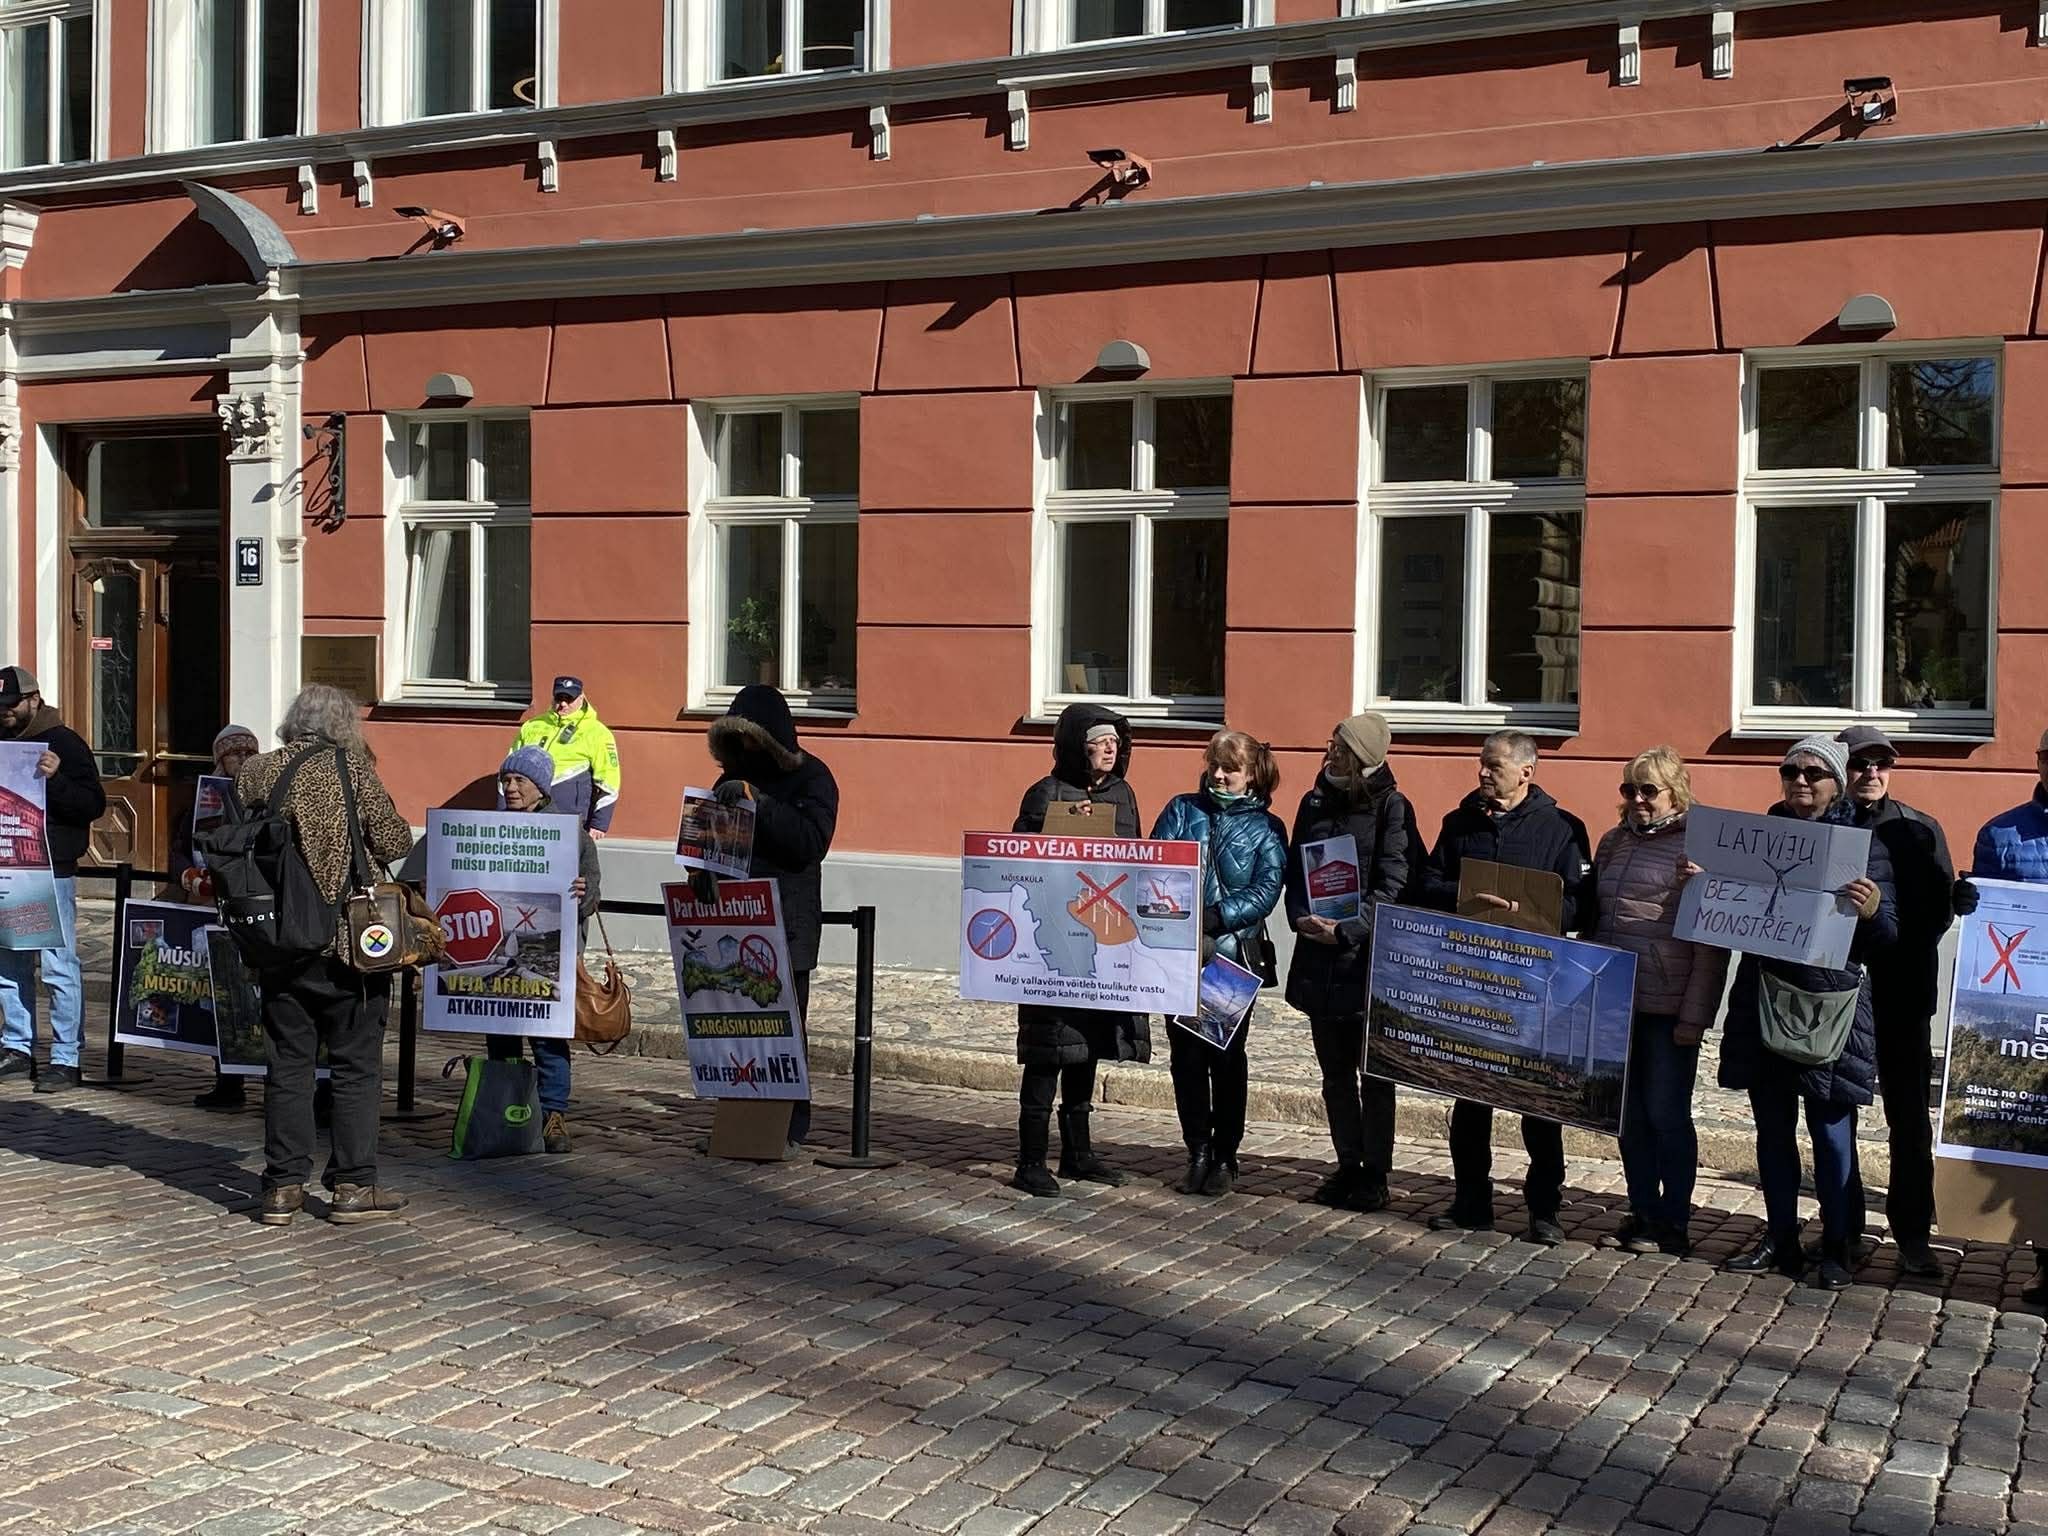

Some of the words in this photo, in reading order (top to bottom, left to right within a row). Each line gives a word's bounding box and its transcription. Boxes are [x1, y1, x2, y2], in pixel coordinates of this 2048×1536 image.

[241, 548, 257, 566] 16
[442, 822, 477, 836] Dabai
[480, 826, 496, 838] un
[499, 825, 560, 840] Cilvēkiem
[456, 842, 545, 856] nepieciešama
[988, 838, 1031, 855] STOP
[1034, 839, 1078, 857] VĒJA
[1083, 842, 1153, 860] FERMĀM
[1158, 846, 1163, 861] !
[451, 858, 486, 872] mūsu
[489, 859, 550, 874] palīdzība!
[1704, 879, 1750, 901] BEZ
[673, 898, 692, 918] Par
[719, 894, 767, 920] Latviju!
[230, 911, 281, 925] bugat
[440, 910, 494, 942] STOP
[1392, 918, 1403, 929] TU
[1693, 906, 1812, 948] MONSTRIEM
[158, 946, 200, 968] MŪSU
[1389, 952, 1400, 962] TU
[144, 974, 188, 993] MŪSU
[994, 974, 1020, 986] Mulgi
[1021, 976, 1065, 987] vallavõim
[1066, 979, 1096, 989] võitleb
[1098, 982, 1137, 992] tuulikute
[1140, 986, 1165, 994] vastu
[1023, 987, 1057, 998] korraga
[1058, 988, 1079, 998] kahe
[1080, 990, 1098, 1000] riigi
[1100, 991, 1130, 1002] kohtus
[1386, 988, 1398, 998] TU
[448, 998, 550, 1019] ATKRITUMIEM!
[695, 1016, 750, 1036] SARGĀSIM
[751, 1019, 784, 1035] DABU!
[1384, 1027, 1396, 1038] TU
[696, 1064, 720, 1081] VĒJA
[768, 1054, 800, 1084] NĒ!
[1966, 1084, 1999, 1097] Skats
[2001, 1089, 2016, 1099] no
[1965, 1096, 1997, 1108] skatu
[1999, 1112, 2015, 1121] TV
